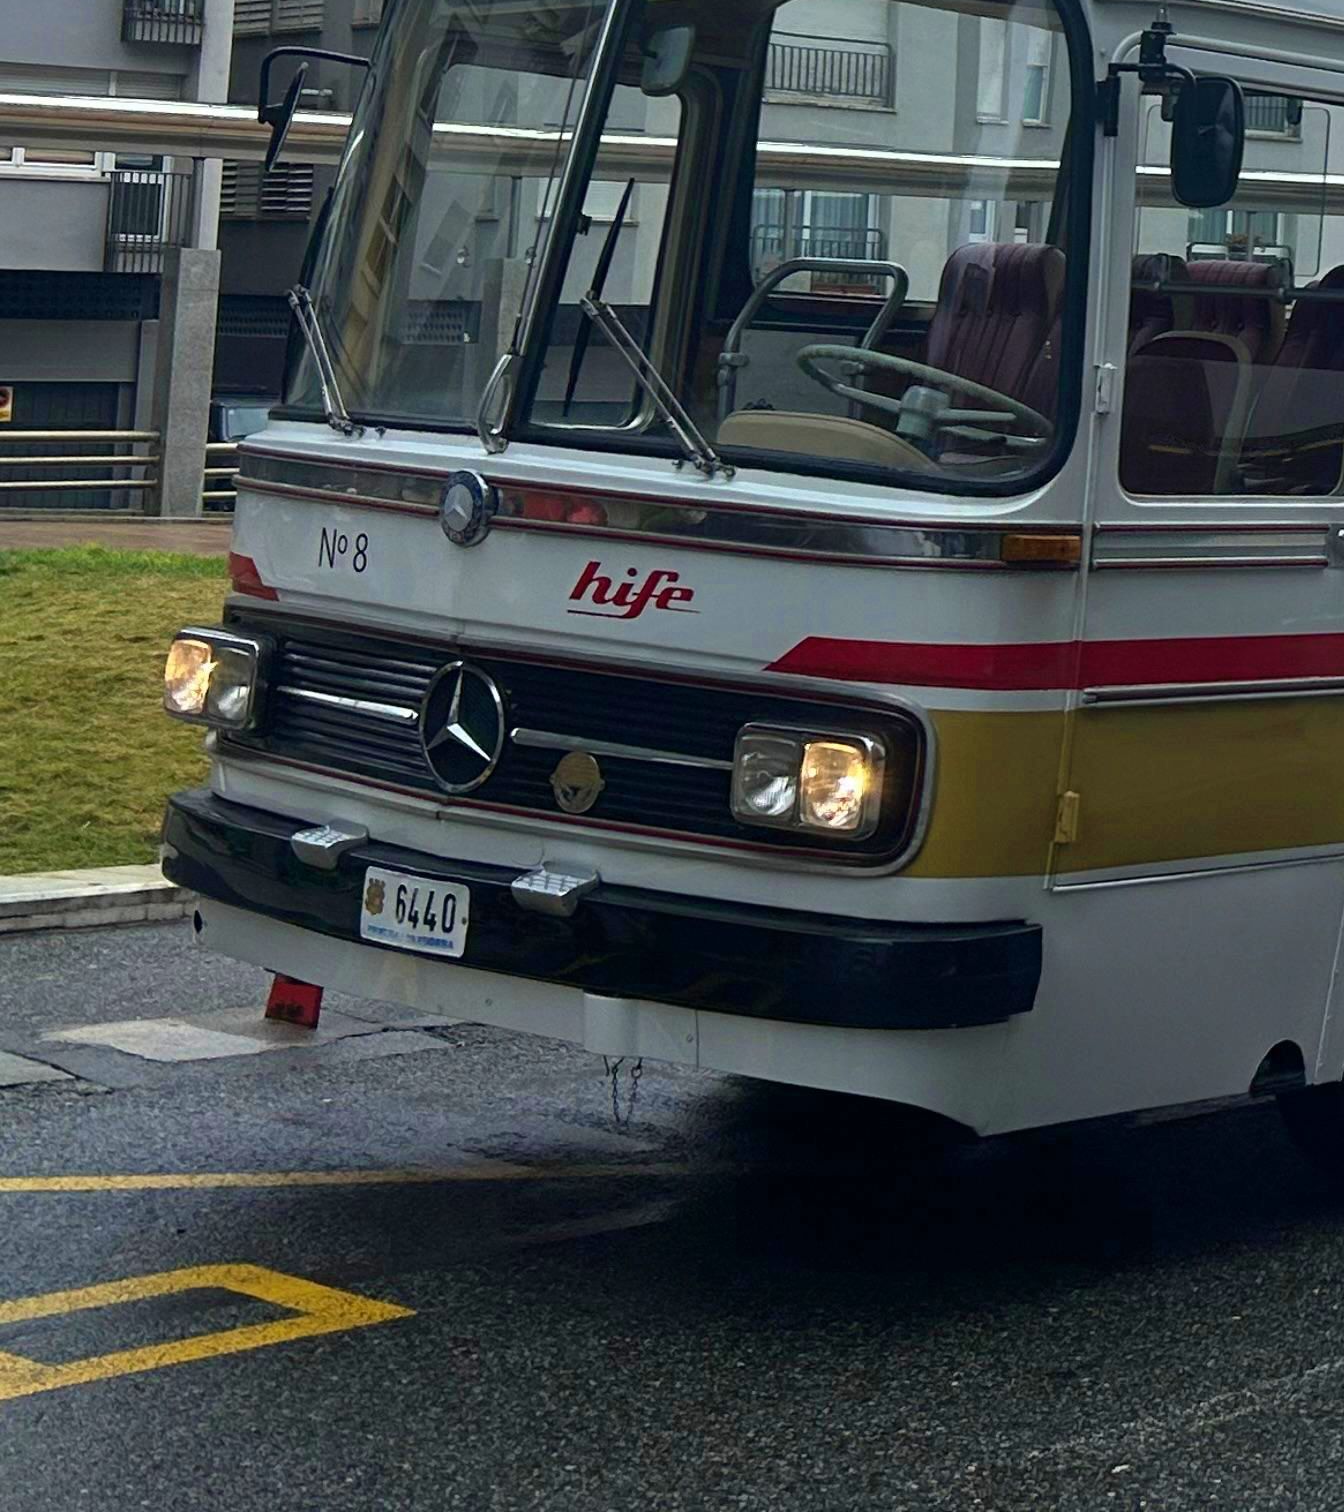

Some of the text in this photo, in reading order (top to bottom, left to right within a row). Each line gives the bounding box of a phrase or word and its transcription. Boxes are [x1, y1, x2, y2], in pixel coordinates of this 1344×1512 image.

[352, 532, 370, 573] 8
[566, 560, 701, 620] hife
[395, 883, 457, 934] 6440
